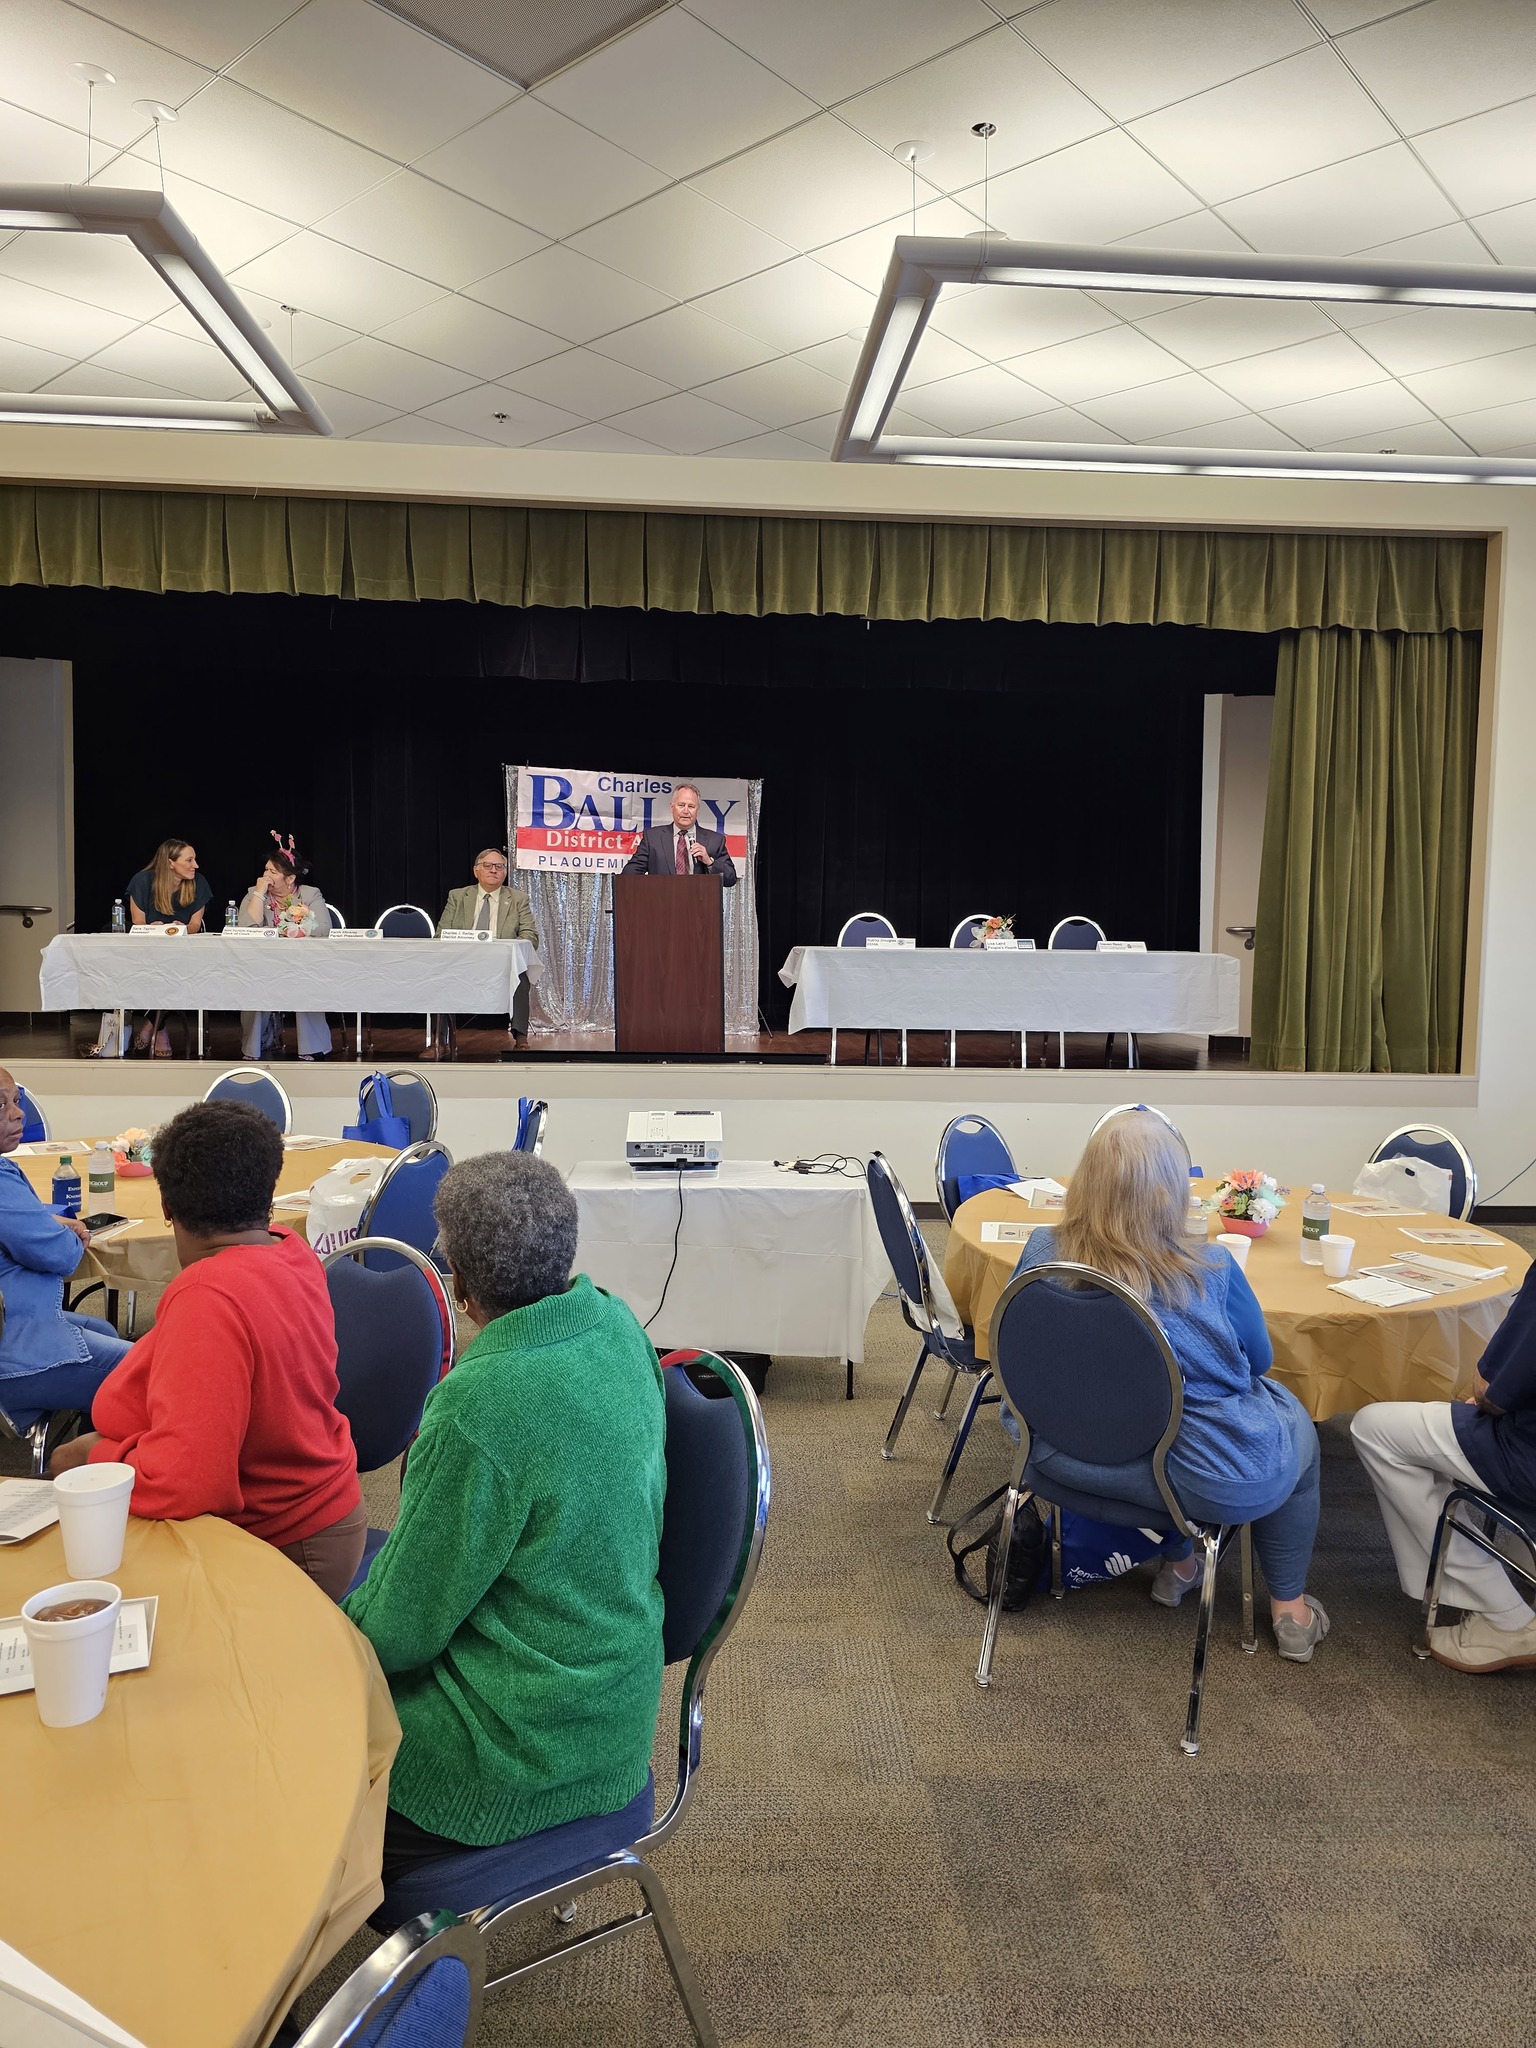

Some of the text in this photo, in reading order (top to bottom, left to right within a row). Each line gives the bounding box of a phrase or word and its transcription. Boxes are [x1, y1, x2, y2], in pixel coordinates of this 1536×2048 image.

[598, 776, 672, 794] Charles
[525, 774, 741, 836] BALLY
[546, 830, 623, 850] District
[538, 855, 624, 869] PLAQUEMI
